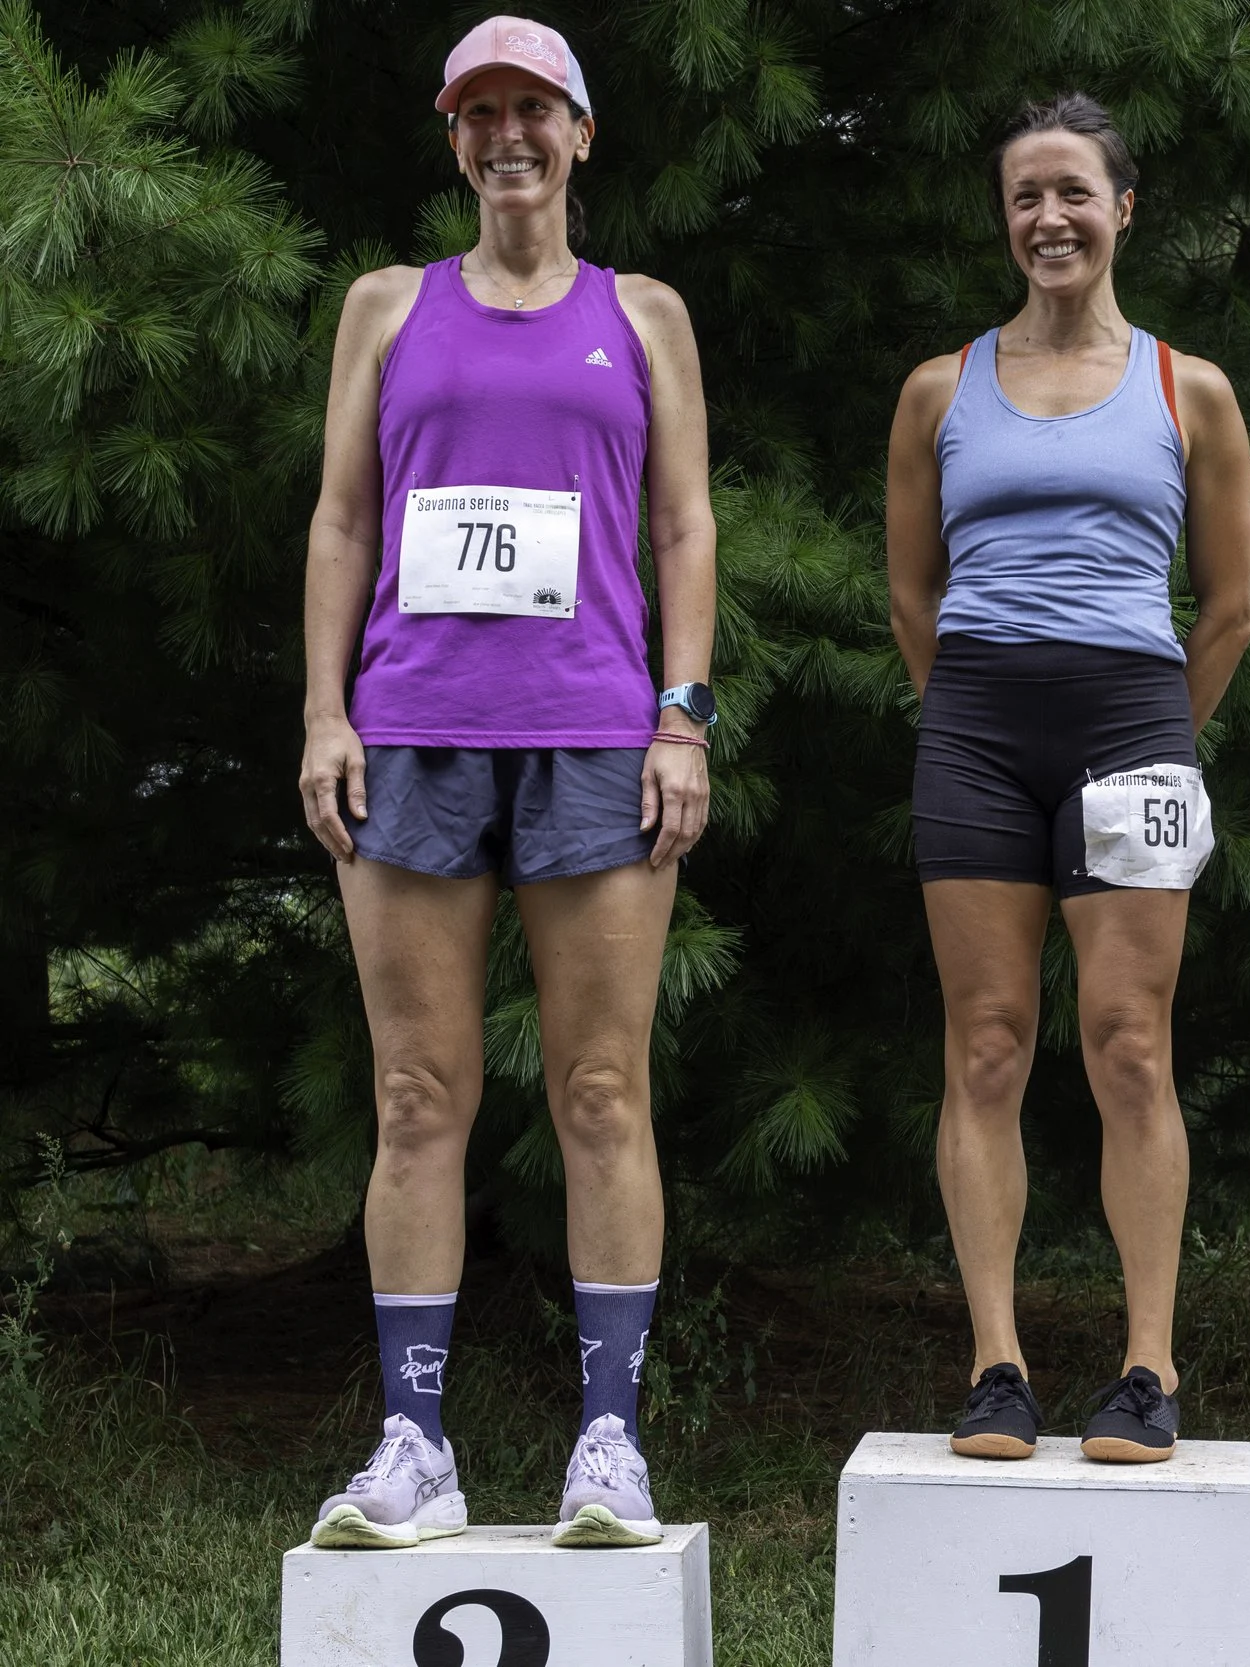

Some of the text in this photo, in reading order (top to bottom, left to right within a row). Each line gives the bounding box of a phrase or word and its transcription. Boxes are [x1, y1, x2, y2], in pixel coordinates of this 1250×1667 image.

[417, 496, 509, 512] Savanna series
[457, 522, 516, 572] 776
[1151, 772, 1182, 788] series
[1144, 798, 1187, 848] 531
[400, 1361, 441, 1379] Run
